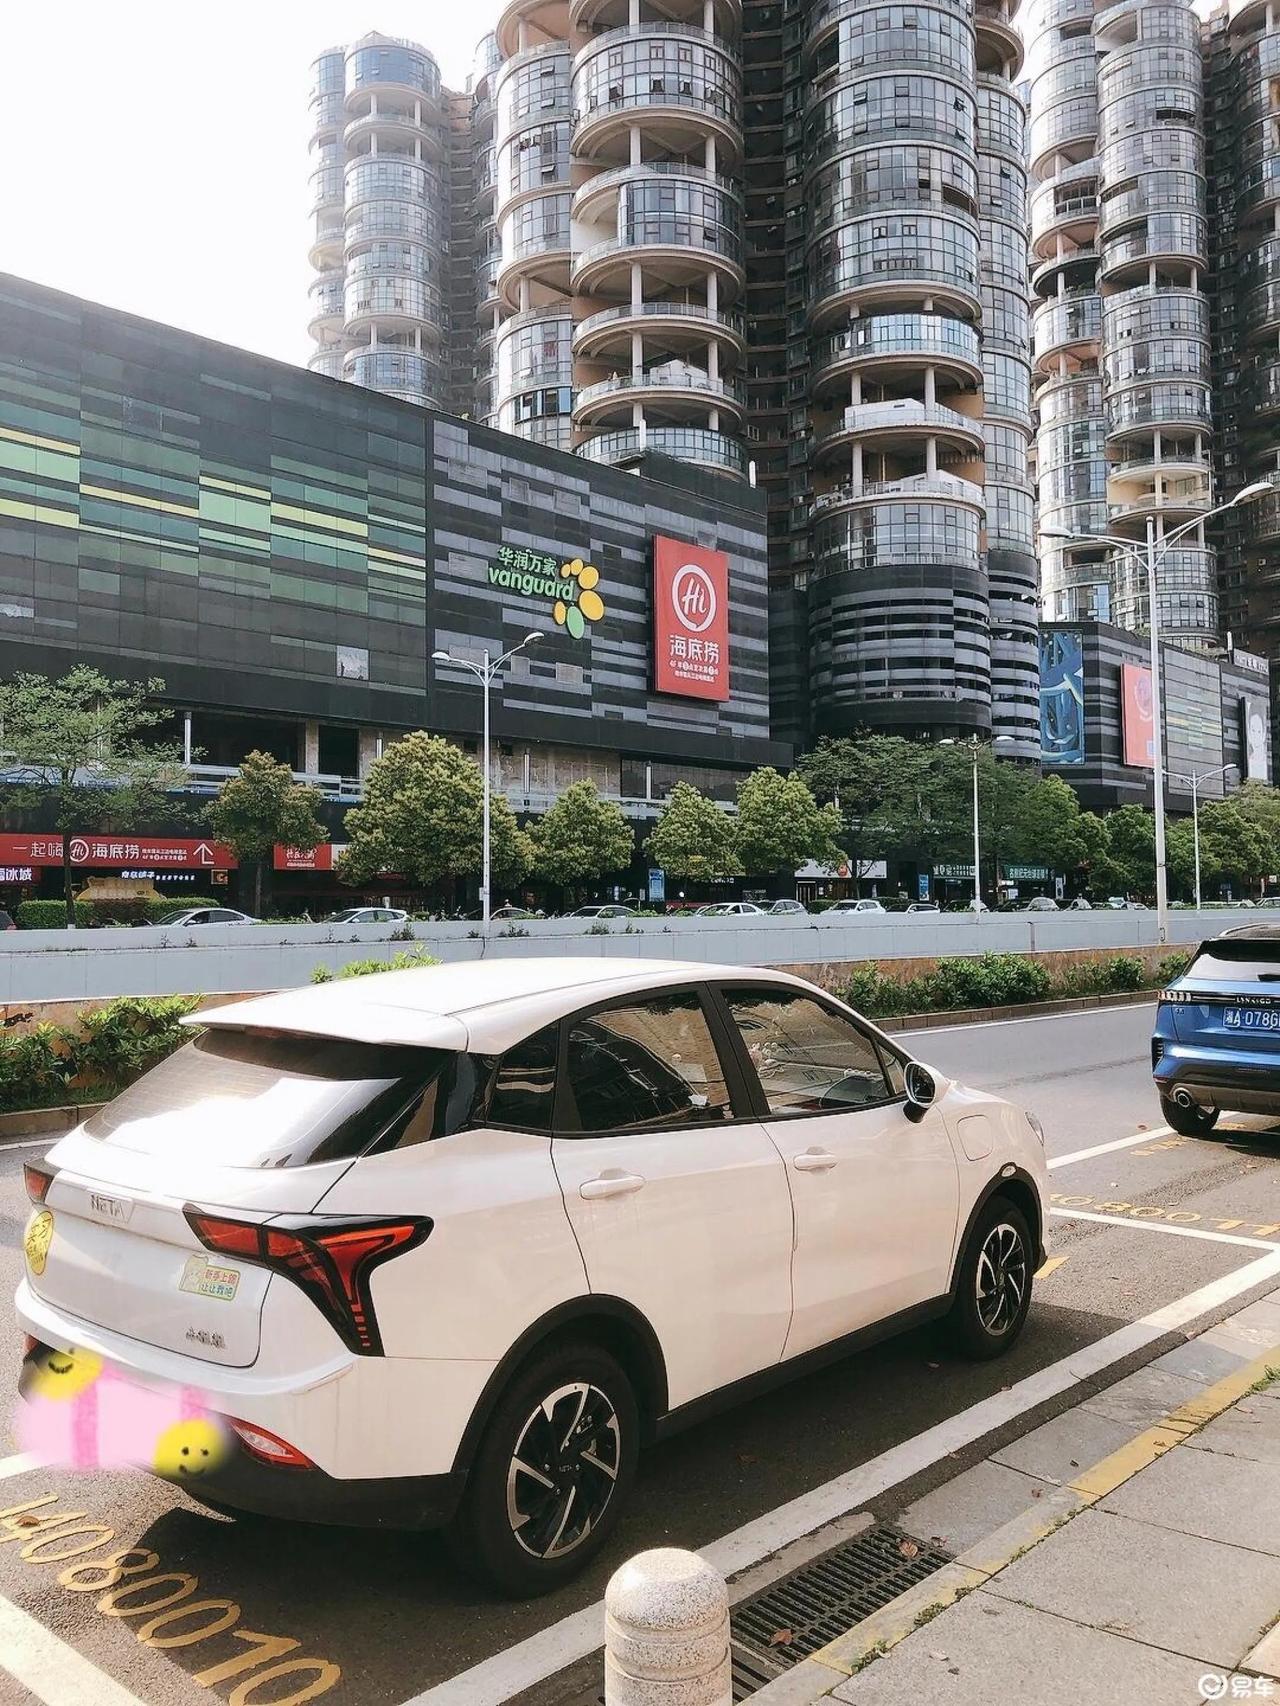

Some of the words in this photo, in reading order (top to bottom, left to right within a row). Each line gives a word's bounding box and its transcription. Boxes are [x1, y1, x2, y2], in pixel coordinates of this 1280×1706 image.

[497, 546, 557, 577] 华润万家
[488, 567, 574, 601] vanguard
[682, 578, 706, 615] Hi
[669, 635, 720, 664] 海底捞
[92, 843, 140, 859] 海底捞
